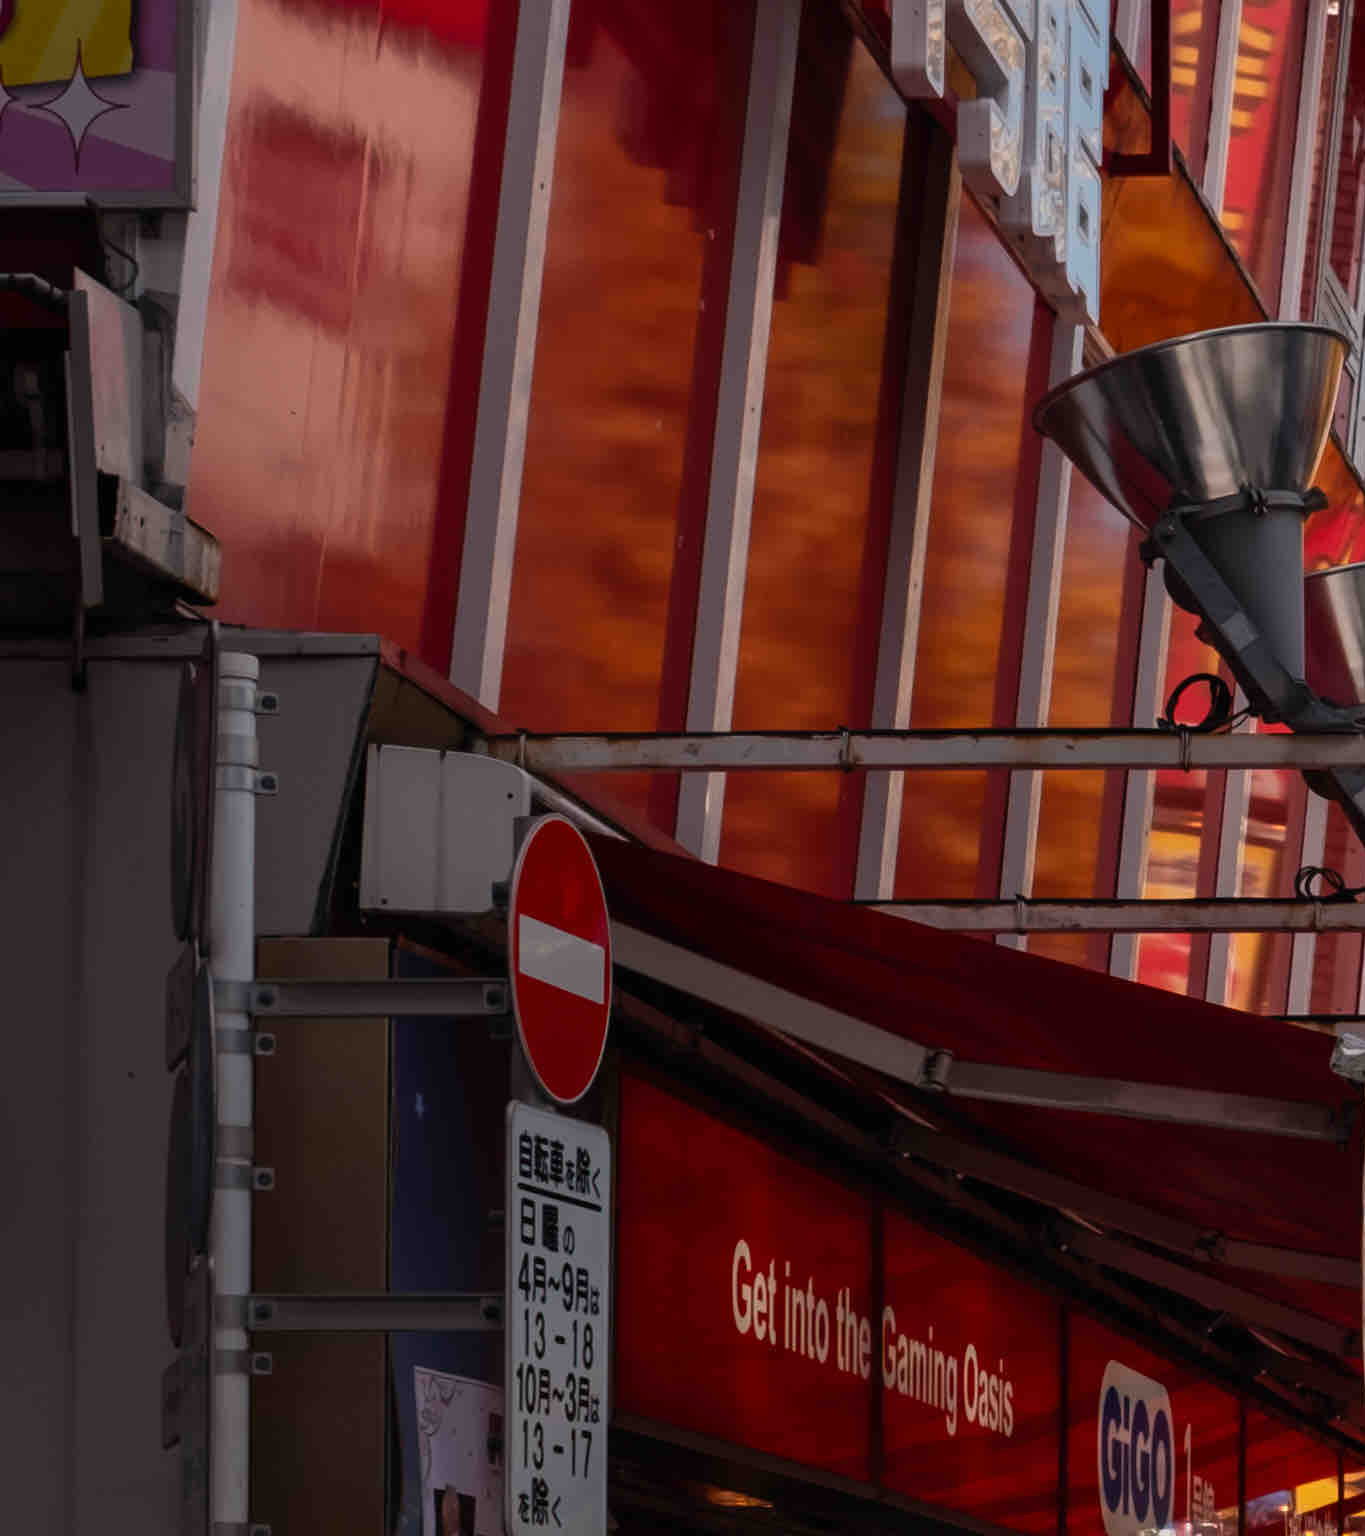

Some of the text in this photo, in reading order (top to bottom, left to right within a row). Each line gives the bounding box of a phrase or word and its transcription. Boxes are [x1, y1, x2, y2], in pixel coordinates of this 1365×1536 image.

[732, 1239, 1014, 1439] Get into the Gaming Oasis
[519, 1477, 562, 1528] を除く
